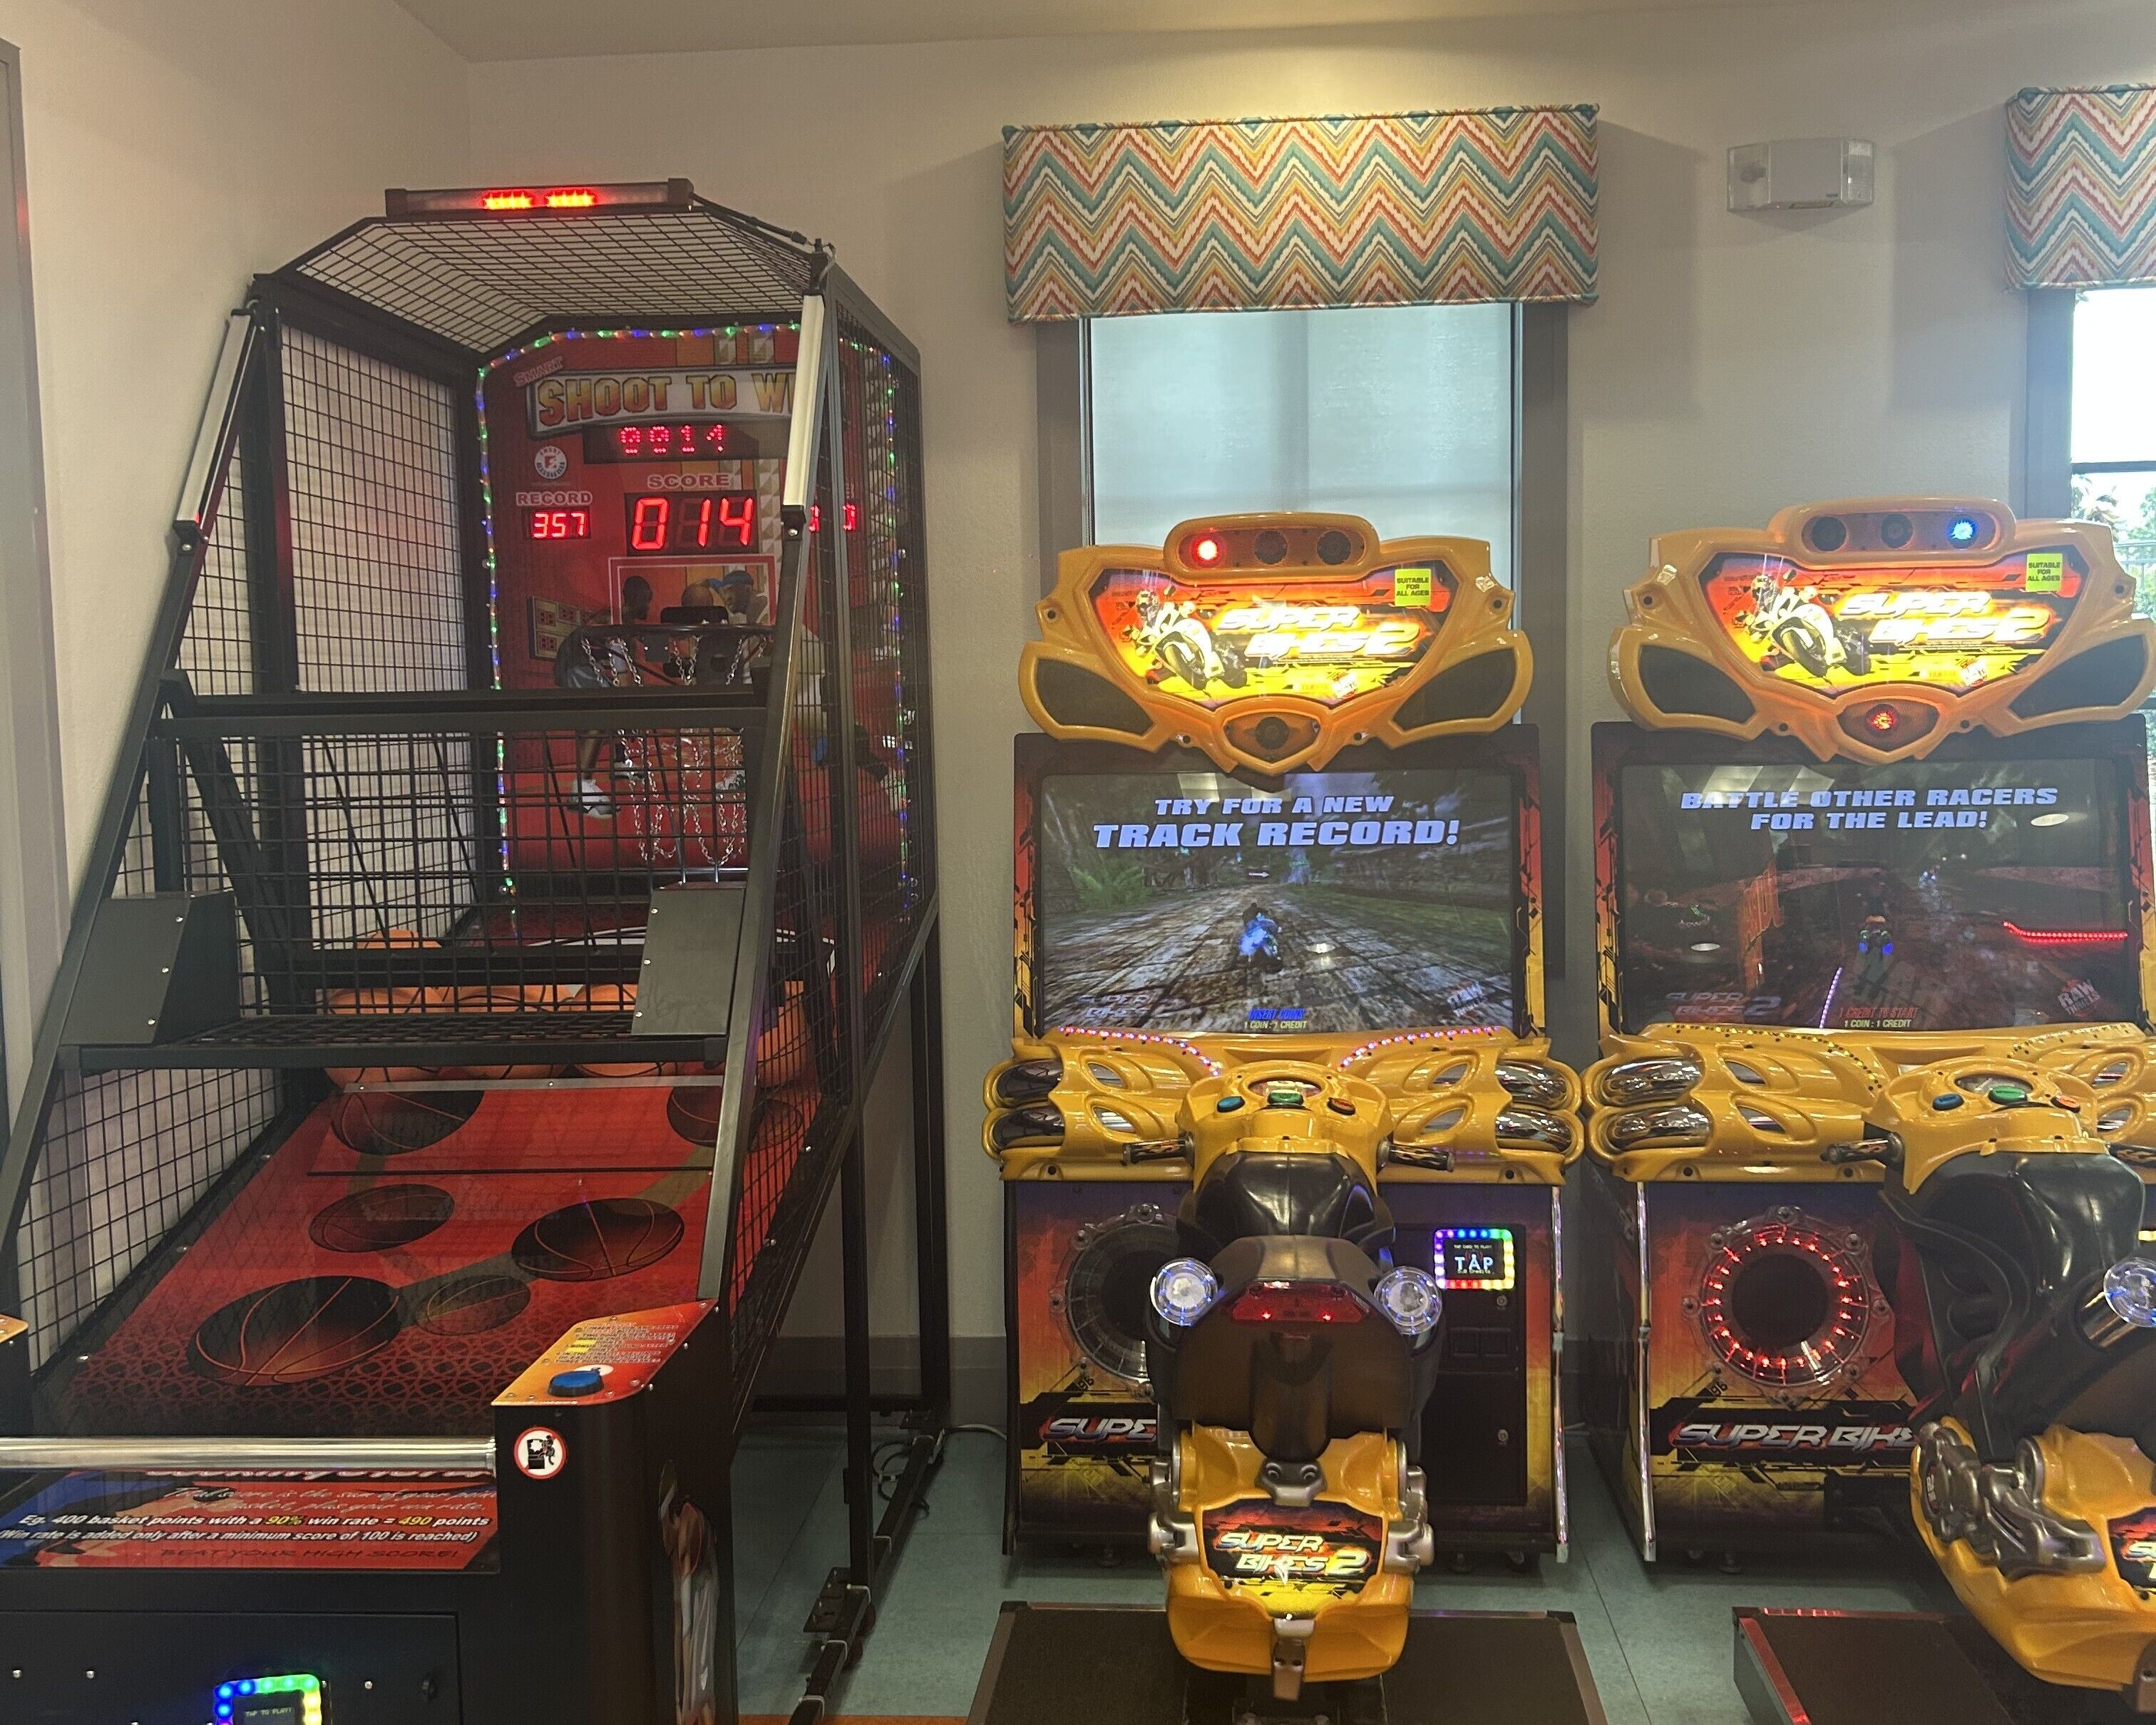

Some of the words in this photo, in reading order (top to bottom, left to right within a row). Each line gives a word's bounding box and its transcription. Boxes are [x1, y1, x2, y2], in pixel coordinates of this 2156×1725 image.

[538, 376, 672, 428] SHOOT
[686, 374, 738, 410] TO
[751, 372, 796, 414] WI
[647, 474, 731, 489] SCORE
[516, 491, 592, 506] RECORD
[533, 512, 587, 540] 357
[632, 497, 754, 551] 014
[1994, 607, 2050, 642] 2
[1365, 623, 1420, 656] 2
[1155, 798, 1212, 815] TRY
[1222, 797, 1283, 814] FOR
[1291, 796, 1313, 814] A
[1323, 796, 1395, 813] NEW
[1681, 791, 1799, 809] BATTLE
[1809, 789, 1916, 807] OTHER
[1926, 788, 2058, 806] RACERS
[1750, 813, 1814, 830] FOR
[1826, 812, 1887, 829] THE
[1897, 811, 1988, 828] LEAD!
[1093, 822, 1244, 848] TRACK
[1256, 819, 1460, 846] RECORD!
[1454, 1254, 1493, 1271] TAP
[1043, 1418, 1157, 1442] SUPE
[1675, 1423, 1827, 1448] SUPER
[1829, 1426, 1915, 1450] BIKE
[19, 1515, 46, 1526] Eg.
[51, 1515, 89, 1524] 400
[87, 1515, 150, 1525] basket
[146, 1516, 204, 1527] points
[208, 1515, 247, 1525] with
[265, 1515, 304, 1526] 90%
[308, 1517, 340, 1525] win
[342, 1517, 379, 1525] rate
[398, 1516, 433, 1525] 490
[432, 1517, 490, 1527] points
[29, 1530, 66, 1539] rate
[64, 1530, 83, 1539] is
[82, 1530, 136, 1540] added
[133, 1530, 167, 1542] only
[167, 1530, 207, 1540] after
[220, 1530, 292, 1540] minimum
[339, 1530, 360, 1540] of
[360, 1530, 391, 1540] 100
[390, 1531, 406, 1540] is
[407, 1531, 478, 1542] reached)
[1218, 1532, 1324, 1552] SUPER
[1235, 1552, 1330, 1575] BIKES
[1325, 1549, 1369, 1576] 2
